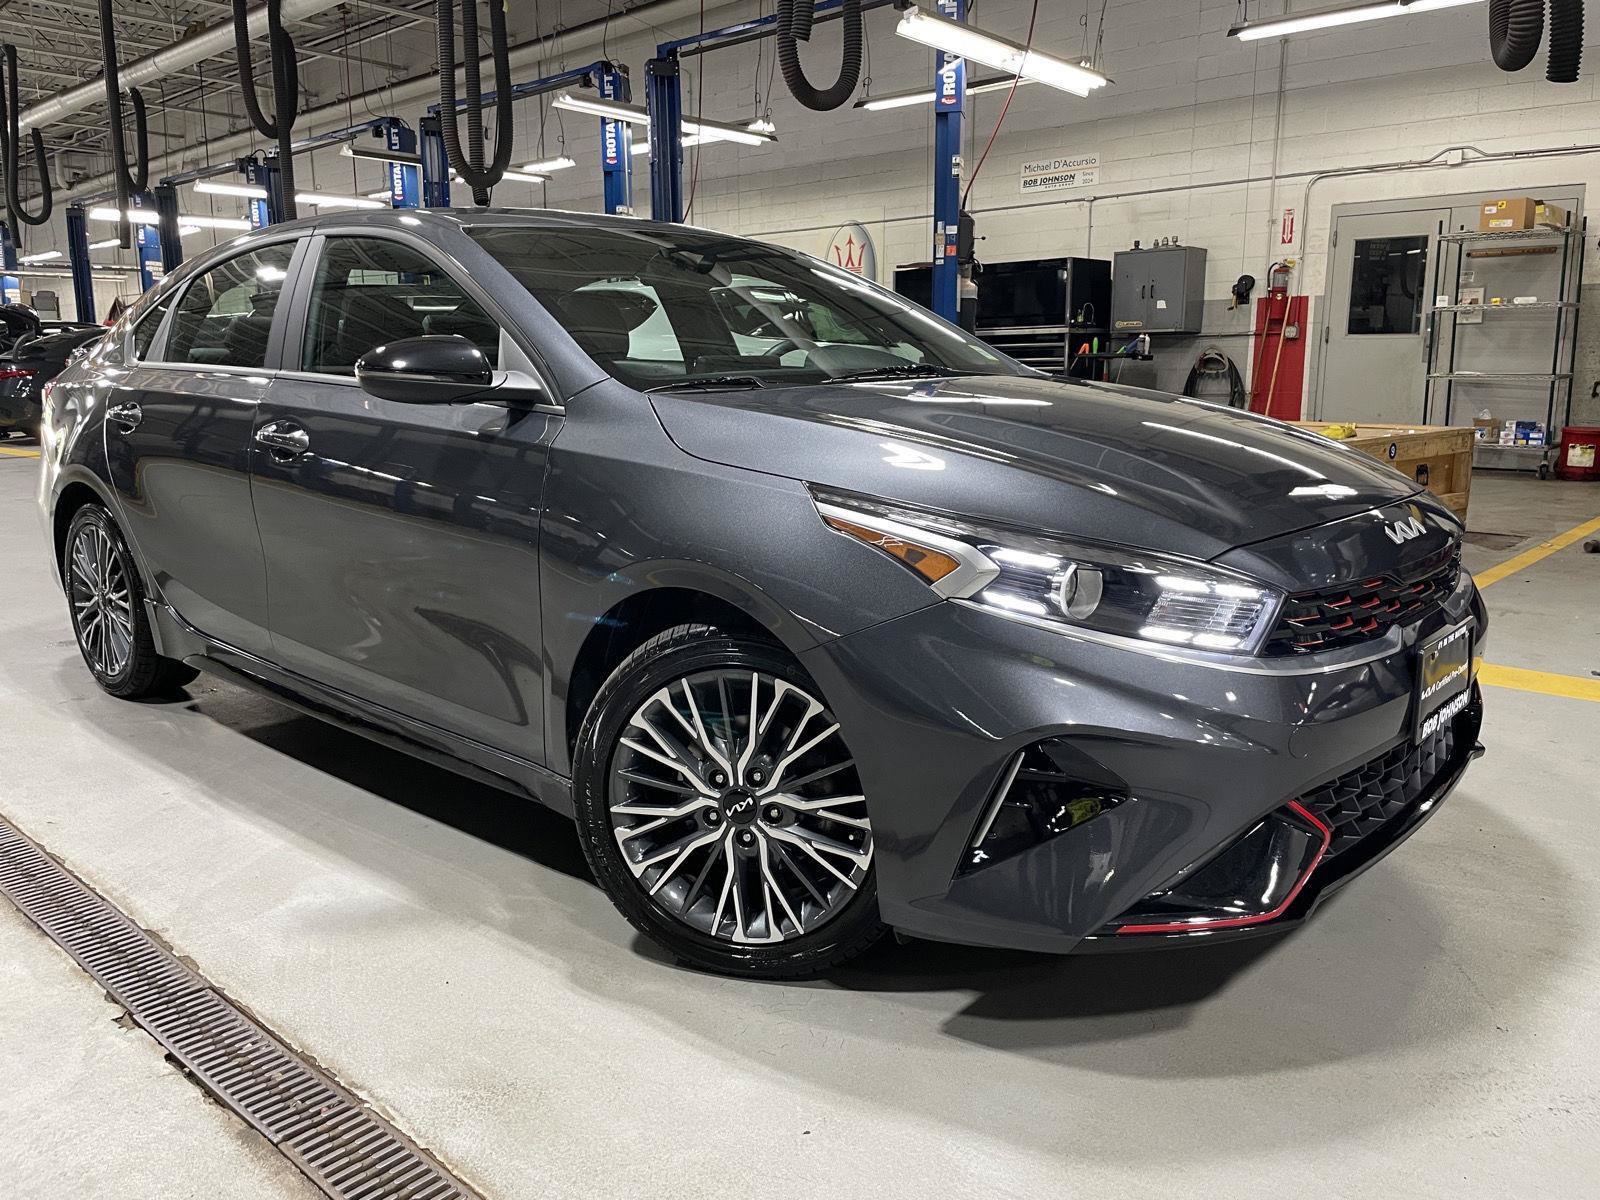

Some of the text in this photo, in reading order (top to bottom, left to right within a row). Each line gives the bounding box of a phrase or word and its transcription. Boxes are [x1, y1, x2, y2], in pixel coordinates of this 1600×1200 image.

[943, 52, 956, 95] ROTA
[604, 75, 616, 157] ROTA LIFT
[391, 127, 403, 195] ROTA LIFT
[1023, 174, 1075, 186] BOB JOHNSON
[1024, 158, 1096, 173] Michael D'Accursio
[1384, 516, 1427, 545] KIA
[1422, 688, 1469, 738] BOB JOHNSON
